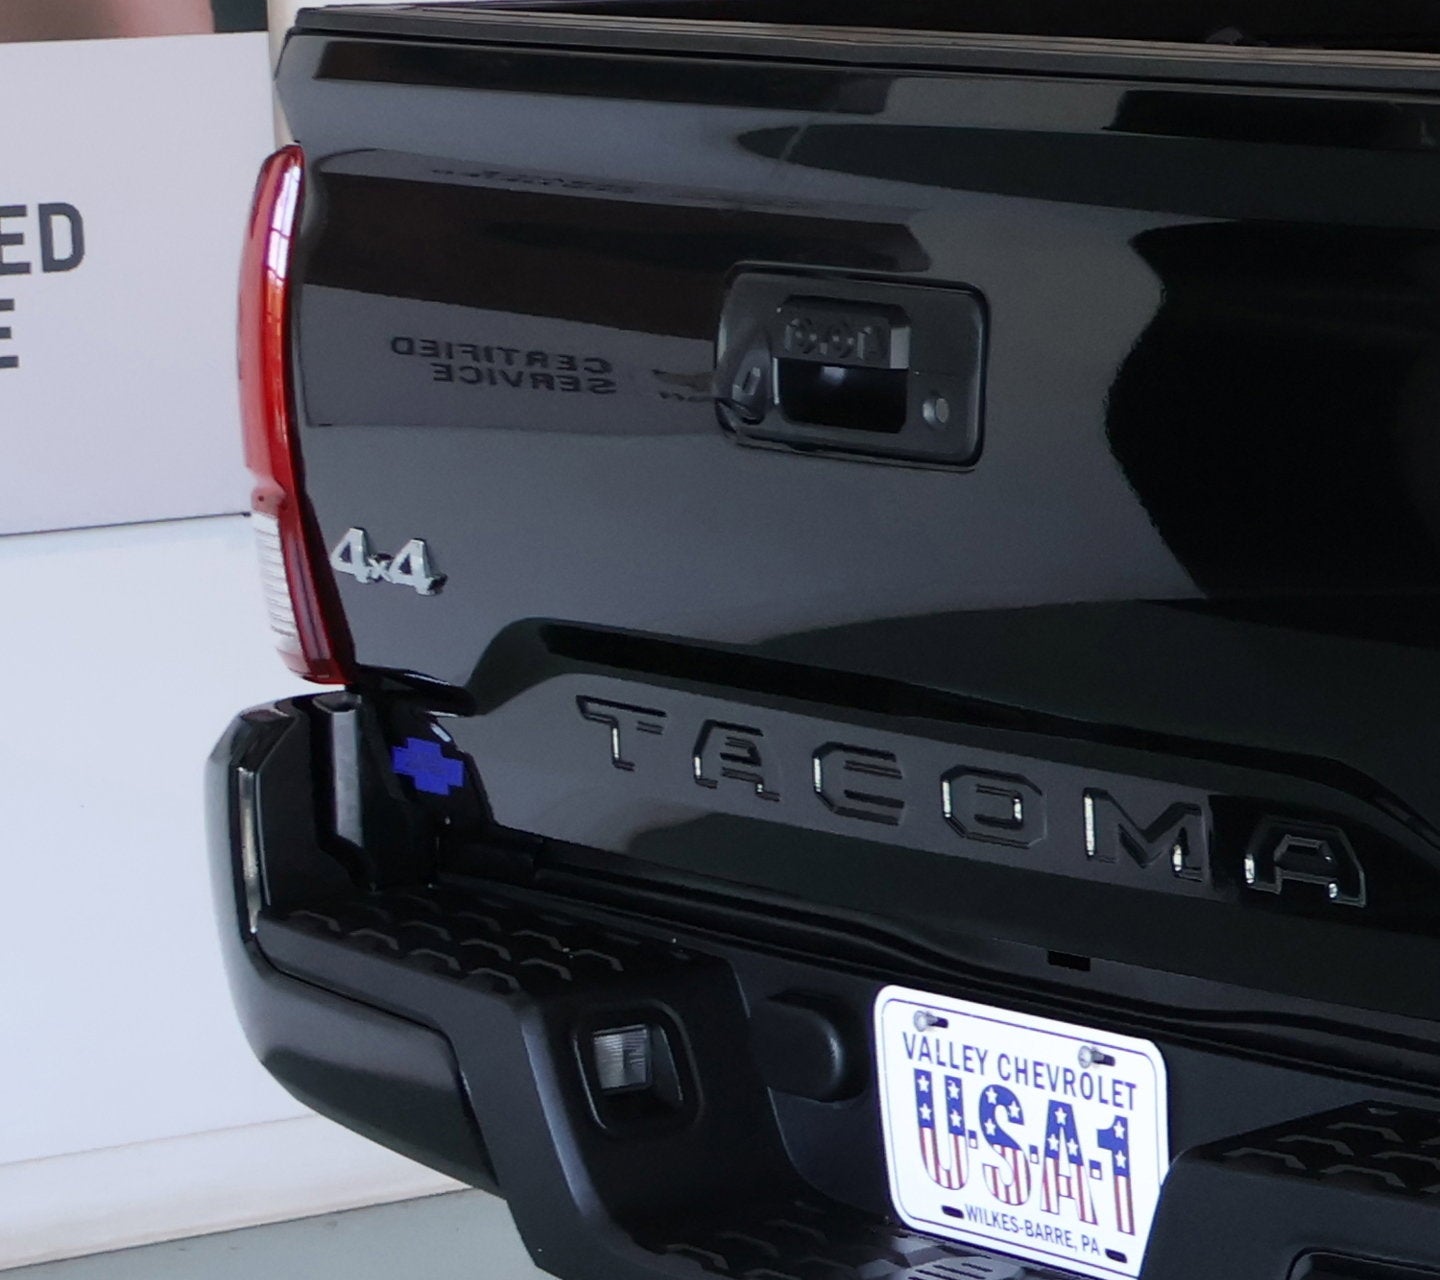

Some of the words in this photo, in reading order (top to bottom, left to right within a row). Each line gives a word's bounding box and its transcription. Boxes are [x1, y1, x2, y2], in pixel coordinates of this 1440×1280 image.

[575, 694, 1367, 908] TACOMA
[902, 1031, 988, 1076] VALLEY
[998, 1053, 1137, 1111] CHEVROLET
[965, 1204, 1078, 1251] WILKES-BARRE,
[1081, 1236, 1101, 1256] PA
